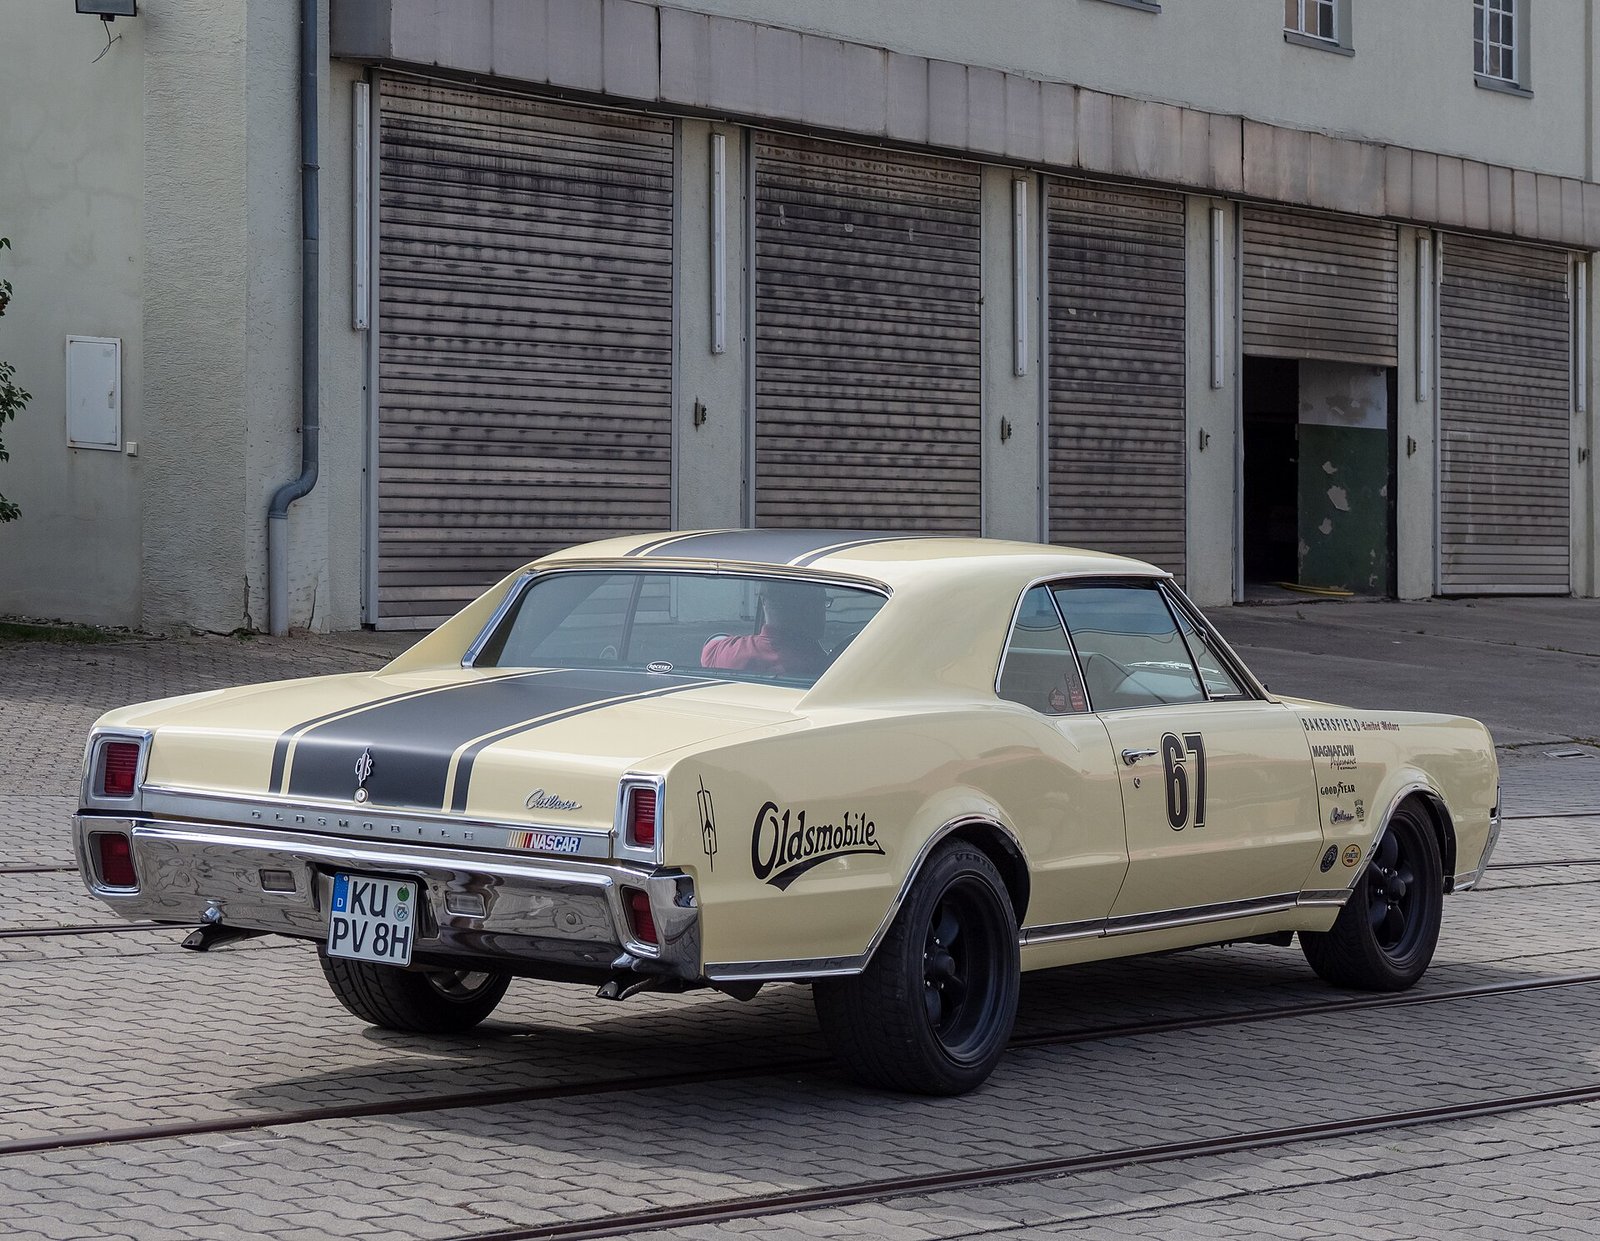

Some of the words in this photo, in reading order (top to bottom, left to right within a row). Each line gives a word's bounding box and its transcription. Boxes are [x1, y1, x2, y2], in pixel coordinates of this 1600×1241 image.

[1301, 718, 1361, 732] BAKERSFIELD
[1312, 744, 1355, 758] MAGNAFLOW
[1160, 732, 1208, 832] 67
[525, 788, 582, 811] Cutlass
[251, 810, 474, 841] OLDSMOBILE
[529, 832, 580, 854] NASCAR
[751, 801, 886, 881] Oldsmobile
[336, 897, 344, 908] D
[350, 880, 389, 918] KU
[331, 917, 369, 953] PV
[372, 922, 410, 959] 8H
